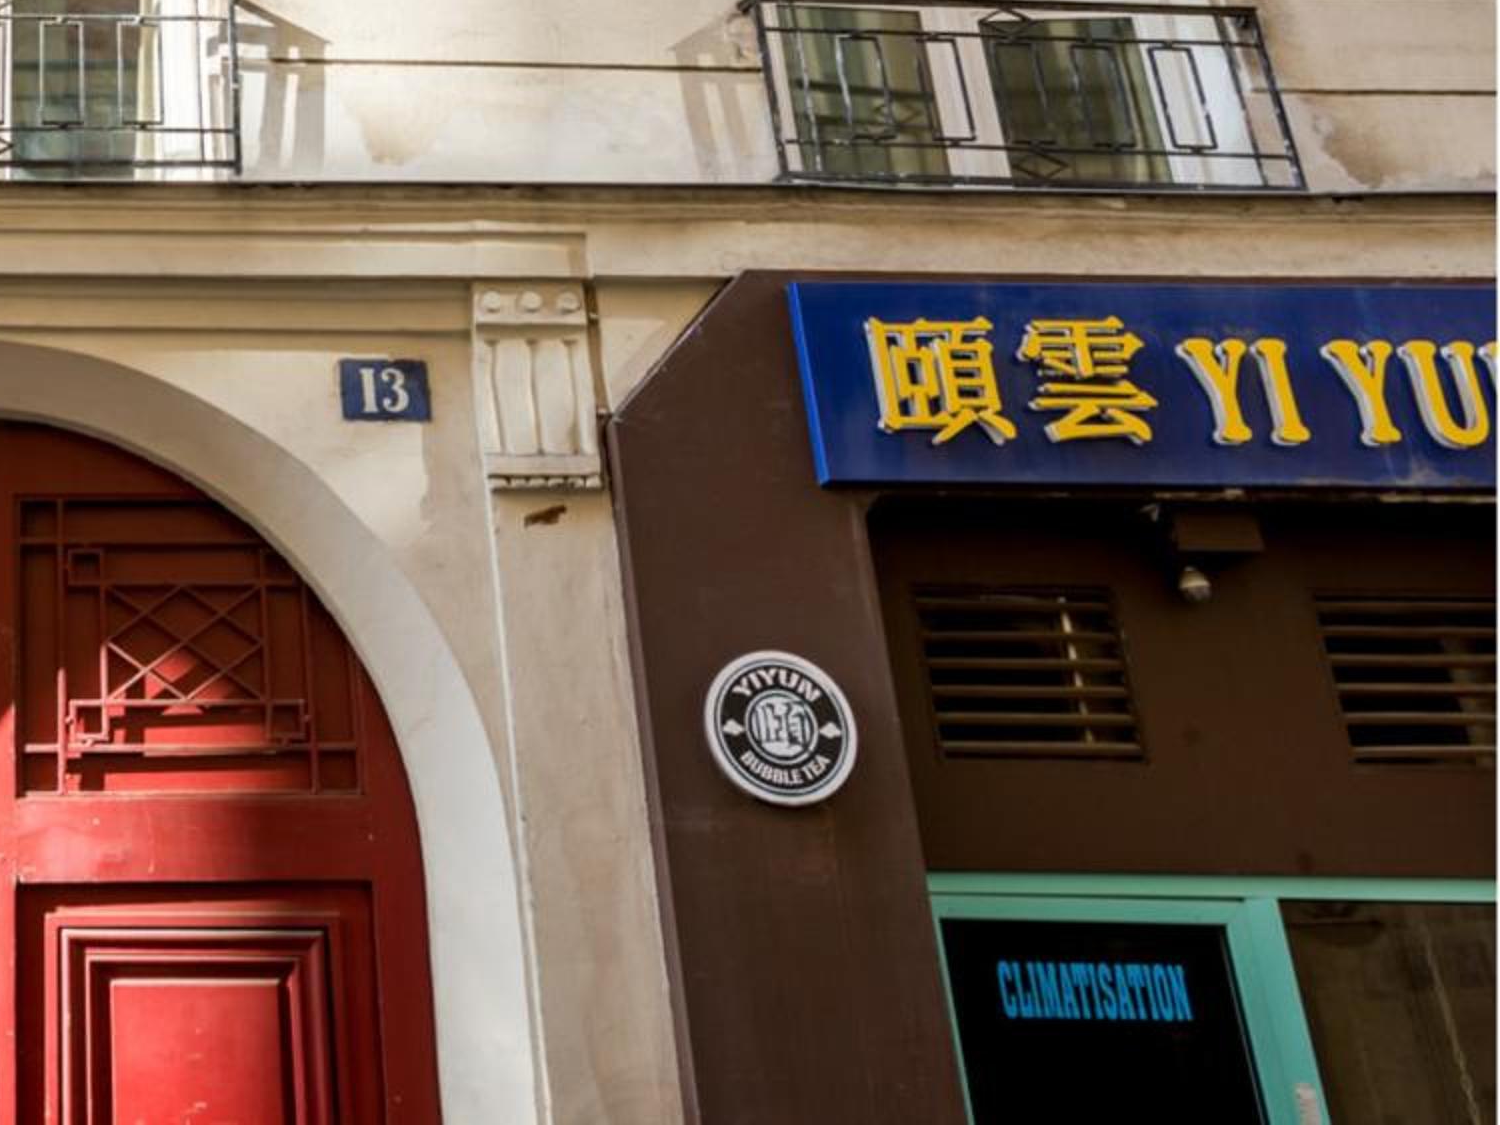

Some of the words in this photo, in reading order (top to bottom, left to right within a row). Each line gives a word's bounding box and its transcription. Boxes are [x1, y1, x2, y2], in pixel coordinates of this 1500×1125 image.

[359, 367, 410, 413] 13
[1175, 339, 1311, 446] YI
[1321, 339, 1497, 449] YU
[731, 668, 821, 701] YIYUN
[740, 750, 804, 785] BUBBLE
[801, 754, 831, 781] TEA
[997, 960, 1194, 1021] CLIMATISATION
